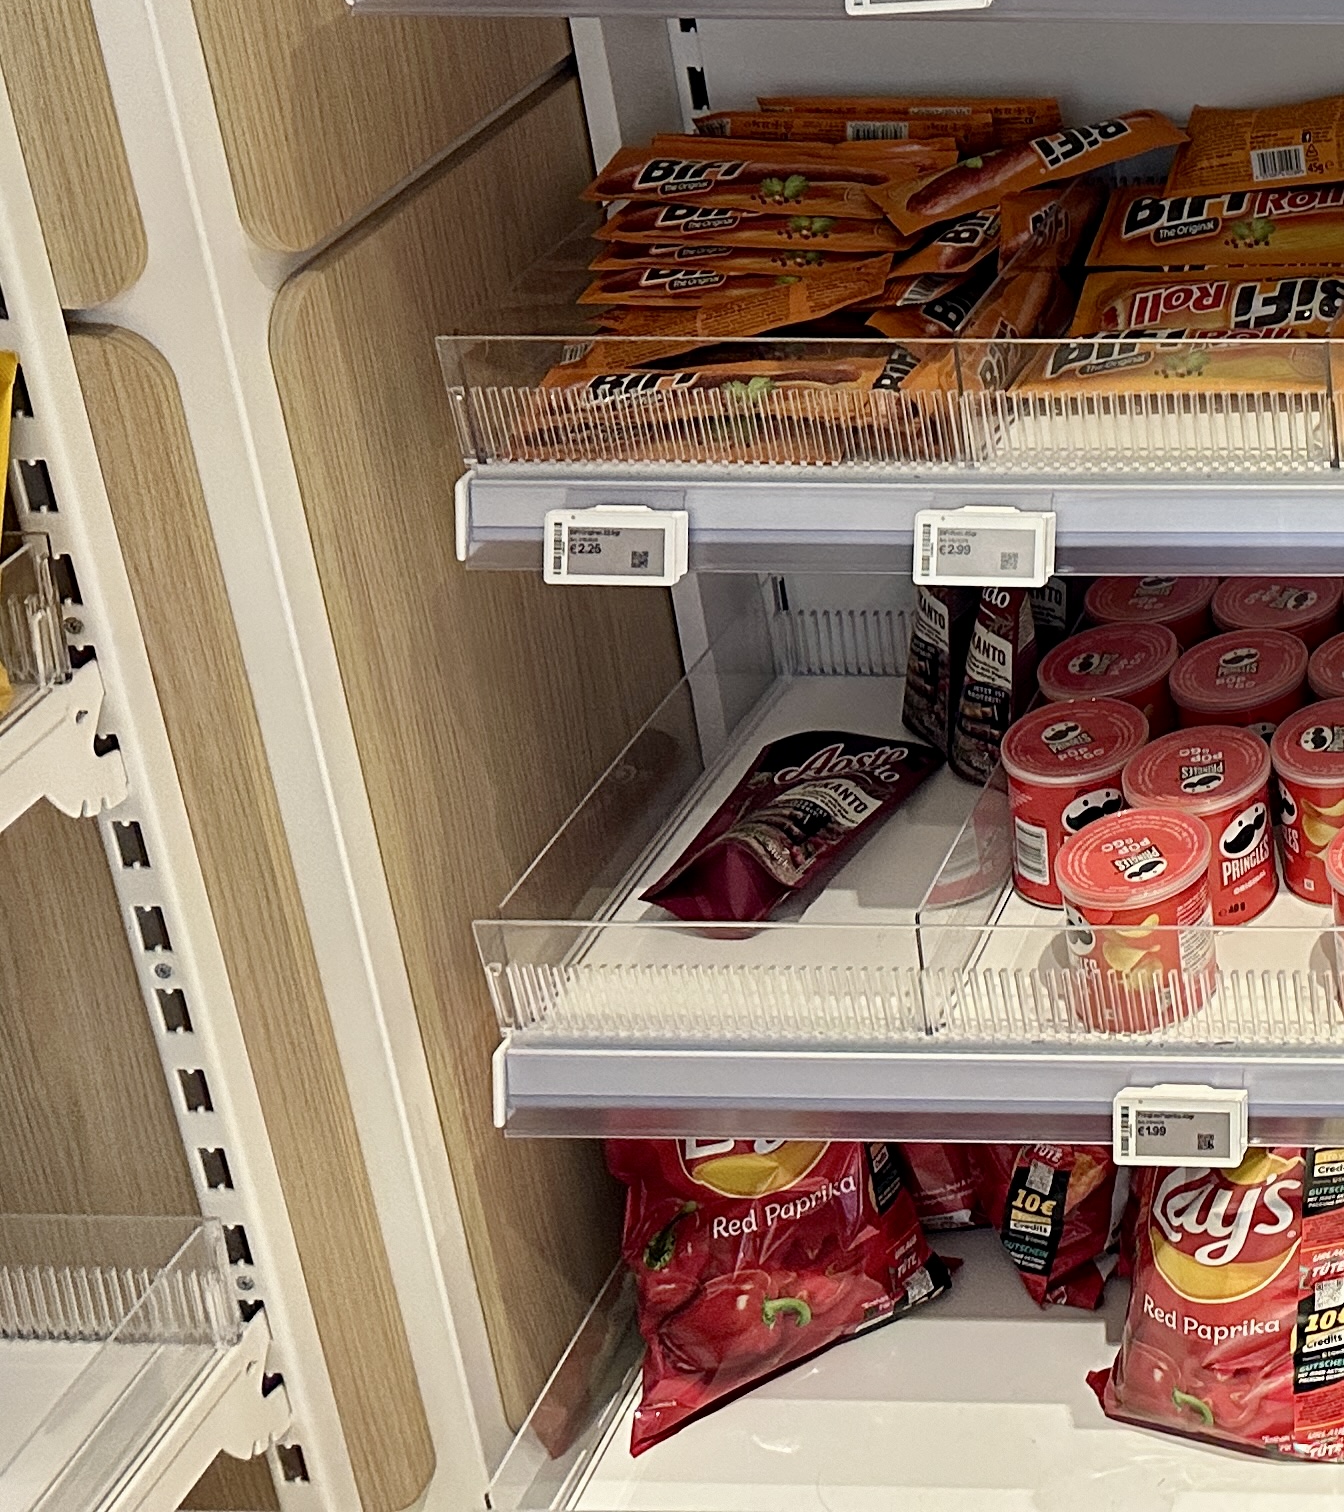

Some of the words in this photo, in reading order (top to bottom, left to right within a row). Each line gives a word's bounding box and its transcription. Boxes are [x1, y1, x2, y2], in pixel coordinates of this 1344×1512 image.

[1177, 220, 1216, 237] Original
[1222, 842, 1269, 886] PRINGLES
[712, 1217, 757, 1239] Red
[765, 1176, 857, 1227] Paprika
[1011, 1190, 1057, 1215] 10€
[1143, 1294, 1177, 1332] Red
[1183, 1317, 1281, 1346] Paprika
